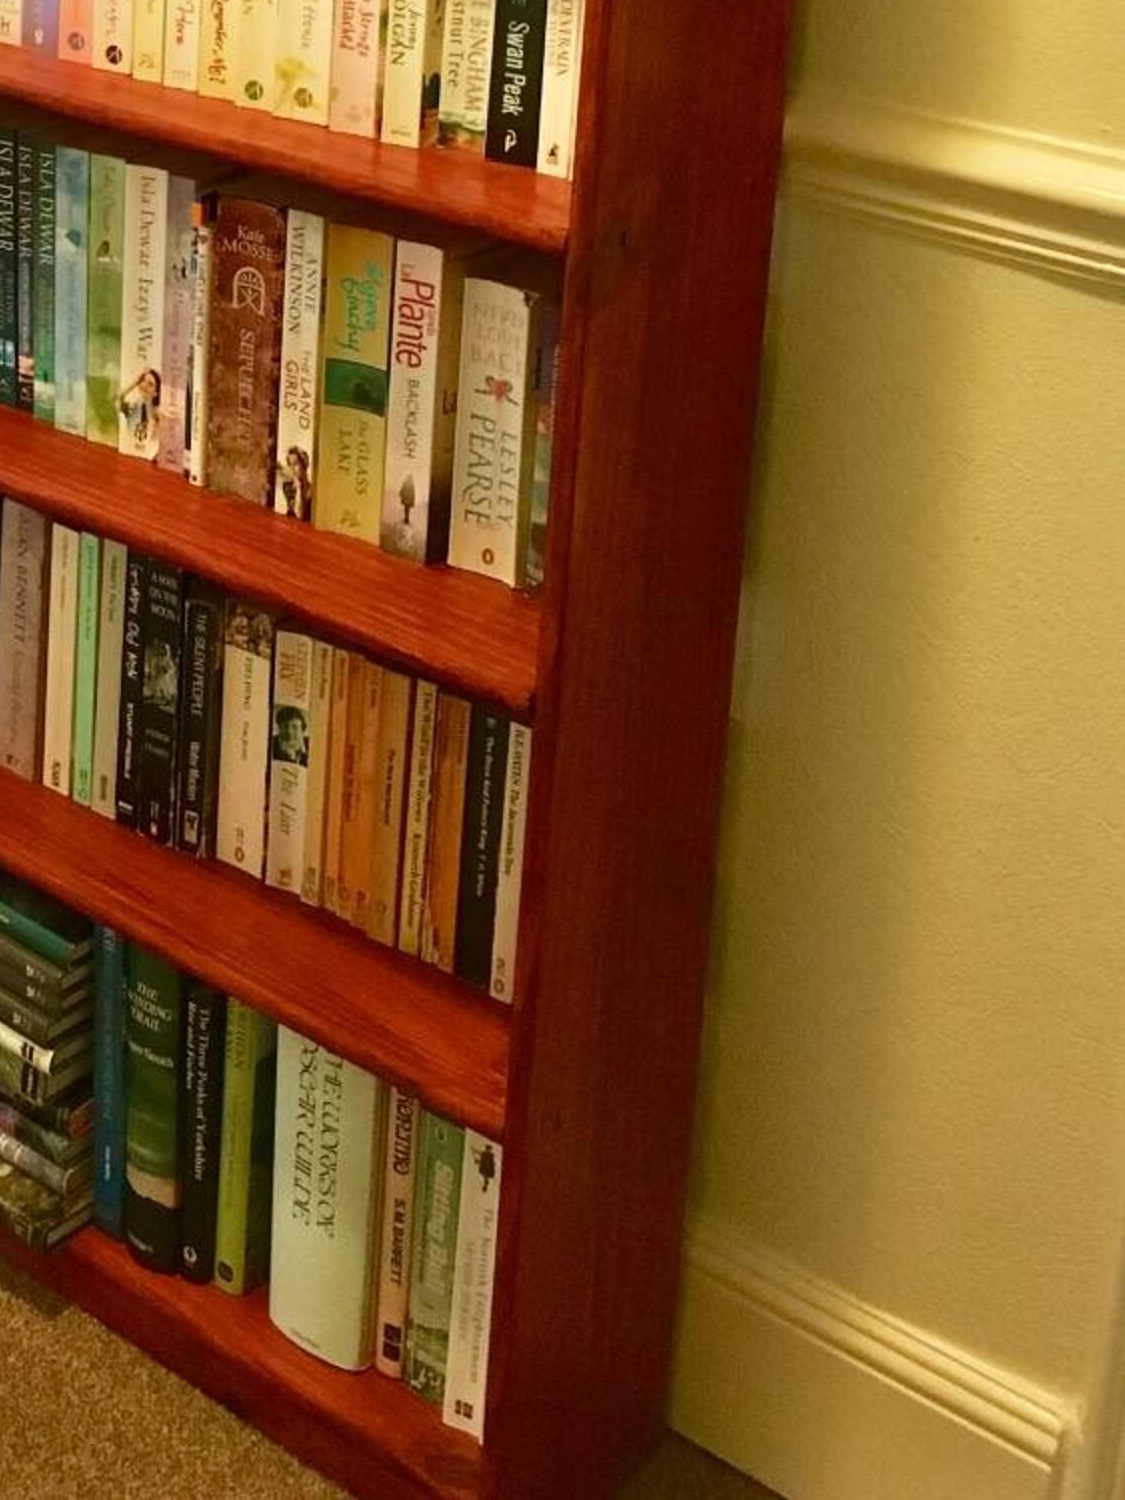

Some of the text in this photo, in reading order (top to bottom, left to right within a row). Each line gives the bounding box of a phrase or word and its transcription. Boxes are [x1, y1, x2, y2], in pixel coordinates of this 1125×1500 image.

[175, 5, 197, 47] Hero
[357, 5, 374, 58] Strings
[405, 7, 422, 52] Jenny
[446, 51, 466, 88] Tree
[464, 18, 489, 113] BINGHAM
[502, 20, 530, 116] Swan Peak
[19, 145, 34, 258] ISLA DEWAR
[38, 151, 55, 265] ISLA DEWAR
[137, 175, 157, 360] Isla Dewar War
[287, 225, 306, 335] WILKINSON
[303, 255, 319, 315] ANNIE
[395, 277, 434, 368] Plante
[283, 360, 301, 412] GIRLS
[298, 377, 312, 430] LAND
[403, 379, 420, 459] BACKLASH
[338, 430, 354, 475] LAKE
[354, 441, 368, 499] GLASS
[462, 412, 496, 524] PEARSE
[497, 430, 519, 531] LESLEY
[190, 614, 207, 718] THE SILENT PEOPLE
[281, 800, 299, 836] Liar
[194, 1008, 210, 1181] The Three Peaks of Yorkshire
[290, 1130, 316, 1227] WILDE
[316, 1057, 344, 1240] THE WORKS OF
[469, 1206, 495, 1384] The Scottish Enlightenment
